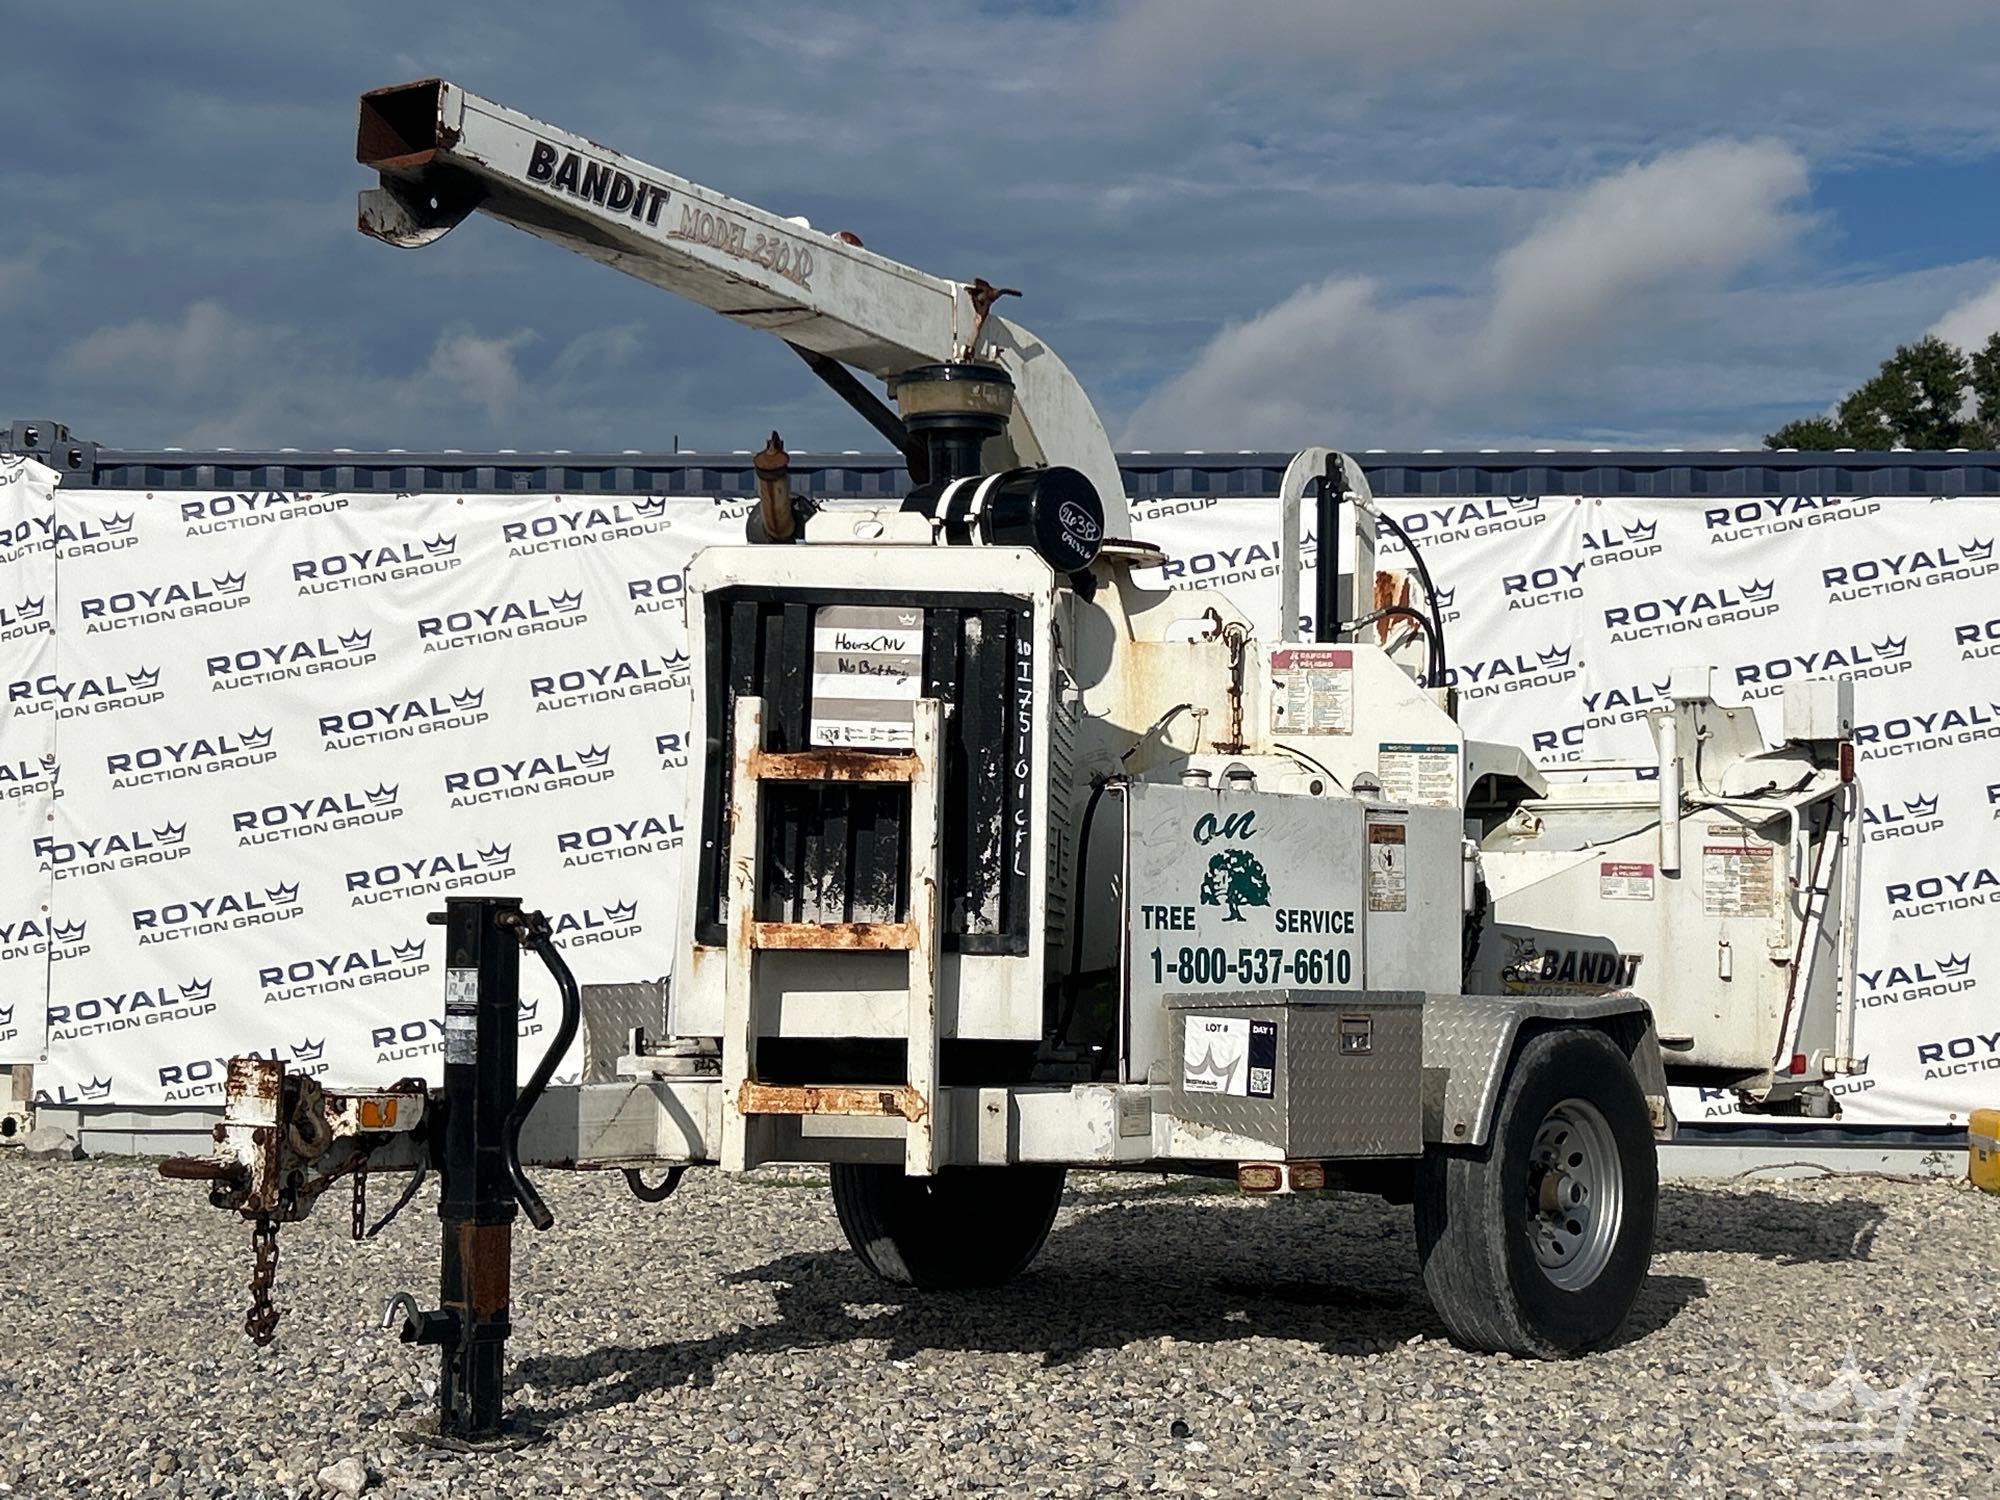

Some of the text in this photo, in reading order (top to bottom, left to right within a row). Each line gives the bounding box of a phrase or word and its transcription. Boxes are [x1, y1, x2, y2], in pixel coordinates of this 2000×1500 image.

[526, 140, 670, 227] BANDIT
[680, 204, 748, 257] MODEL
[186, 499, 348, 537] AUCTION GROUP
[502, 506, 633, 543] ROYAL
[1147, 498, 1217, 520] GROUP
[1375, 499, 1507, 540] ROYAL
[1710, 503, 1881, 544] AUCTION GROUP
[68, 537, 138, 559] GROUP
[508, 521, 671, 559] AUCTION GROUP
[1380, 514, 1545, 556] AUCTION GROUP
[292, 544, 424, 582] ROYAL
[1590, 545, 1662, 567] GROUP
[1822, 548, 1959, 588] ROYAL
[297, 558, 462, 597] AUCTION GROUP
[1169, 570, 1256, 591] AUCTION
[1503, 562, 1584, 595] ROY
[1829, 563, 2000, 603] AUCTION GROUP
[81, 581, 213, 619] ROYAL
[86, 596, 251, 634] AUCTION GROUP
[634, 597, 684, 615] AUCT
[1508, 588, 1584, 611] AUCTIO
[1604, 589, 1740, 629] ROYAL
[1, 621, 50, 642] ROUP
[418, 600, 549, 638] ROYAL
[423, 614, 588, 654] AUCTION GROUP
[1610, 604, 1780, 644] AUCTION GROUP
[207, 638, 338, 676] ROYAL
[212, 653, 377, 692] AUCTION GROUP
[838, 658, 856, 673] No
[1735, 645, 1872, 686] ROYAL
[1838, 661, 1912, 682] GROUP
[530, 658, 662, 698] ROYAL
[535, 675, 691, 713] AUCTION GROU
[1505, 671, 1576, 693] GROUP
[95, 692, 164, 713] GROUP
[319, 698, 451, 736] ROYAL
[324, 712, 488, 752] AUCTION GROUP
[1854, 705, 1991, 745] ROYAL
[1861, 726, 2000, 761] AUCTION GRO
[107, 736, 239, 774] ROYAL
[112, 751, 277, 789] AUCTION GROUP
[445, 753, 576, 793] ROYAL
[450, 769, 615, 808] AUCTION GROUP
[233, 793, 365, 831] ROYAL
[238, 808, 404, 848] AUCTION GROUP
[1871, 819, 1944, 842] GROUP
[120, 847, 191, 869] GROUP
[345, 853, 478, 892] ROYAL
[562, 843, 652, 868] AUCTION
[351, 868, 516, 907] AUCTION GROUP
[1886, 868, 2000, 904] ROYA
[133, 891, 266, 930] ROYAL
[1141, 905, 1355, 933] TREE SERVICE
[1892, 894, 1984, 920] AUCTION
[138, 907, 304, 946] AUCTION GROUP
[571, 925, 642, 947] GROUP
[259, 949, 391, 988] ROYAL
[263, 964, 430, 1004] AUCTION GROUP
[1150, 947, 1351, 984] 1-800-537-6610
[1540, 949, 1643, 986] BANDIT
[1858, 962, 1937, 991] YAL
[48, 988, 179, 1026] ROYAL
[1903, 979, 1976, 1001] GROUP
[52, 1003, 216, 1041] AUCTION GROUP
[1205, 1023, 1222, 1032] LOT
[1918, 1032, 2000, 1064] ROY
[1924, 1057, 2000, 1080] AUCTIO
[165, 1082, 223, 1102] AUCTI
[1832, 1080, 1875, 1096] OUP
